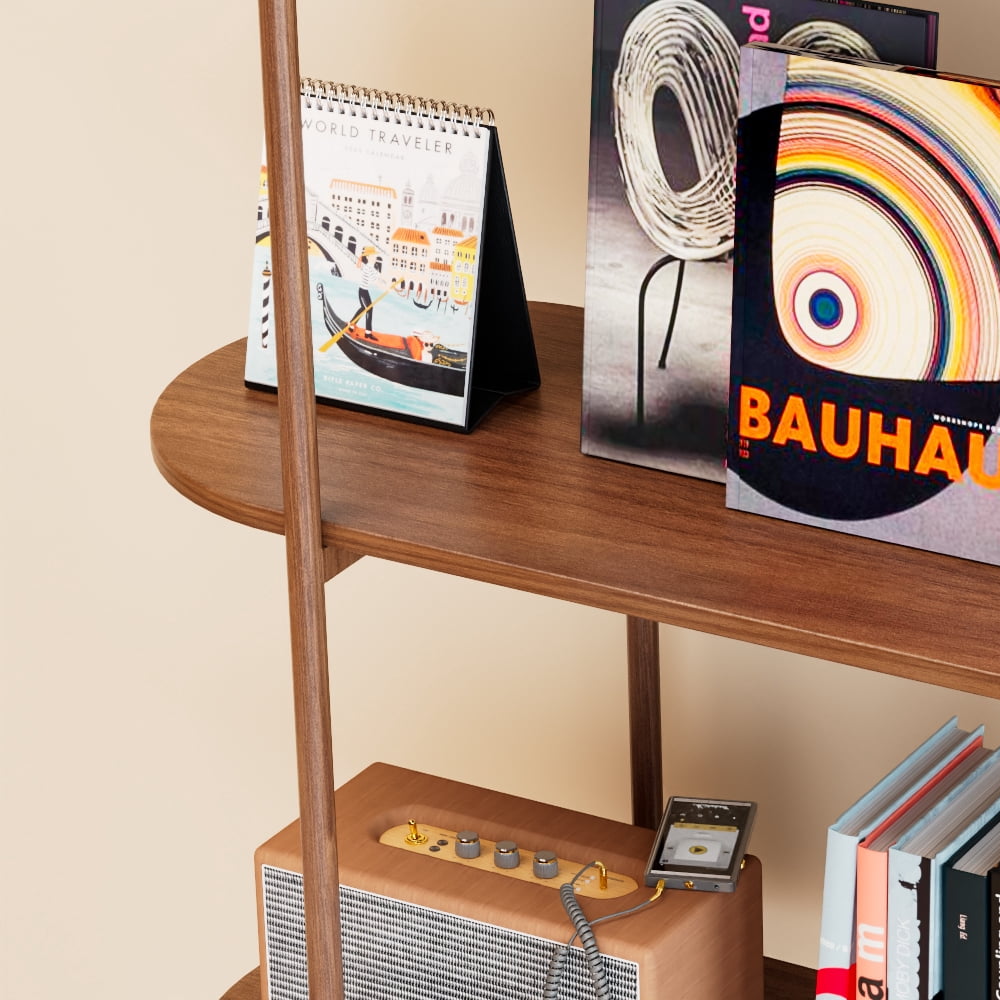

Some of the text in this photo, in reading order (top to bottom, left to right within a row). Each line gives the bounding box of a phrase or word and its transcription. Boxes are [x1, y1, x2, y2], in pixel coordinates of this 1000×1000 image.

[301, 118, 453, 155] WORLD TRAVELER
[895, 916, 912, 957] DICK
